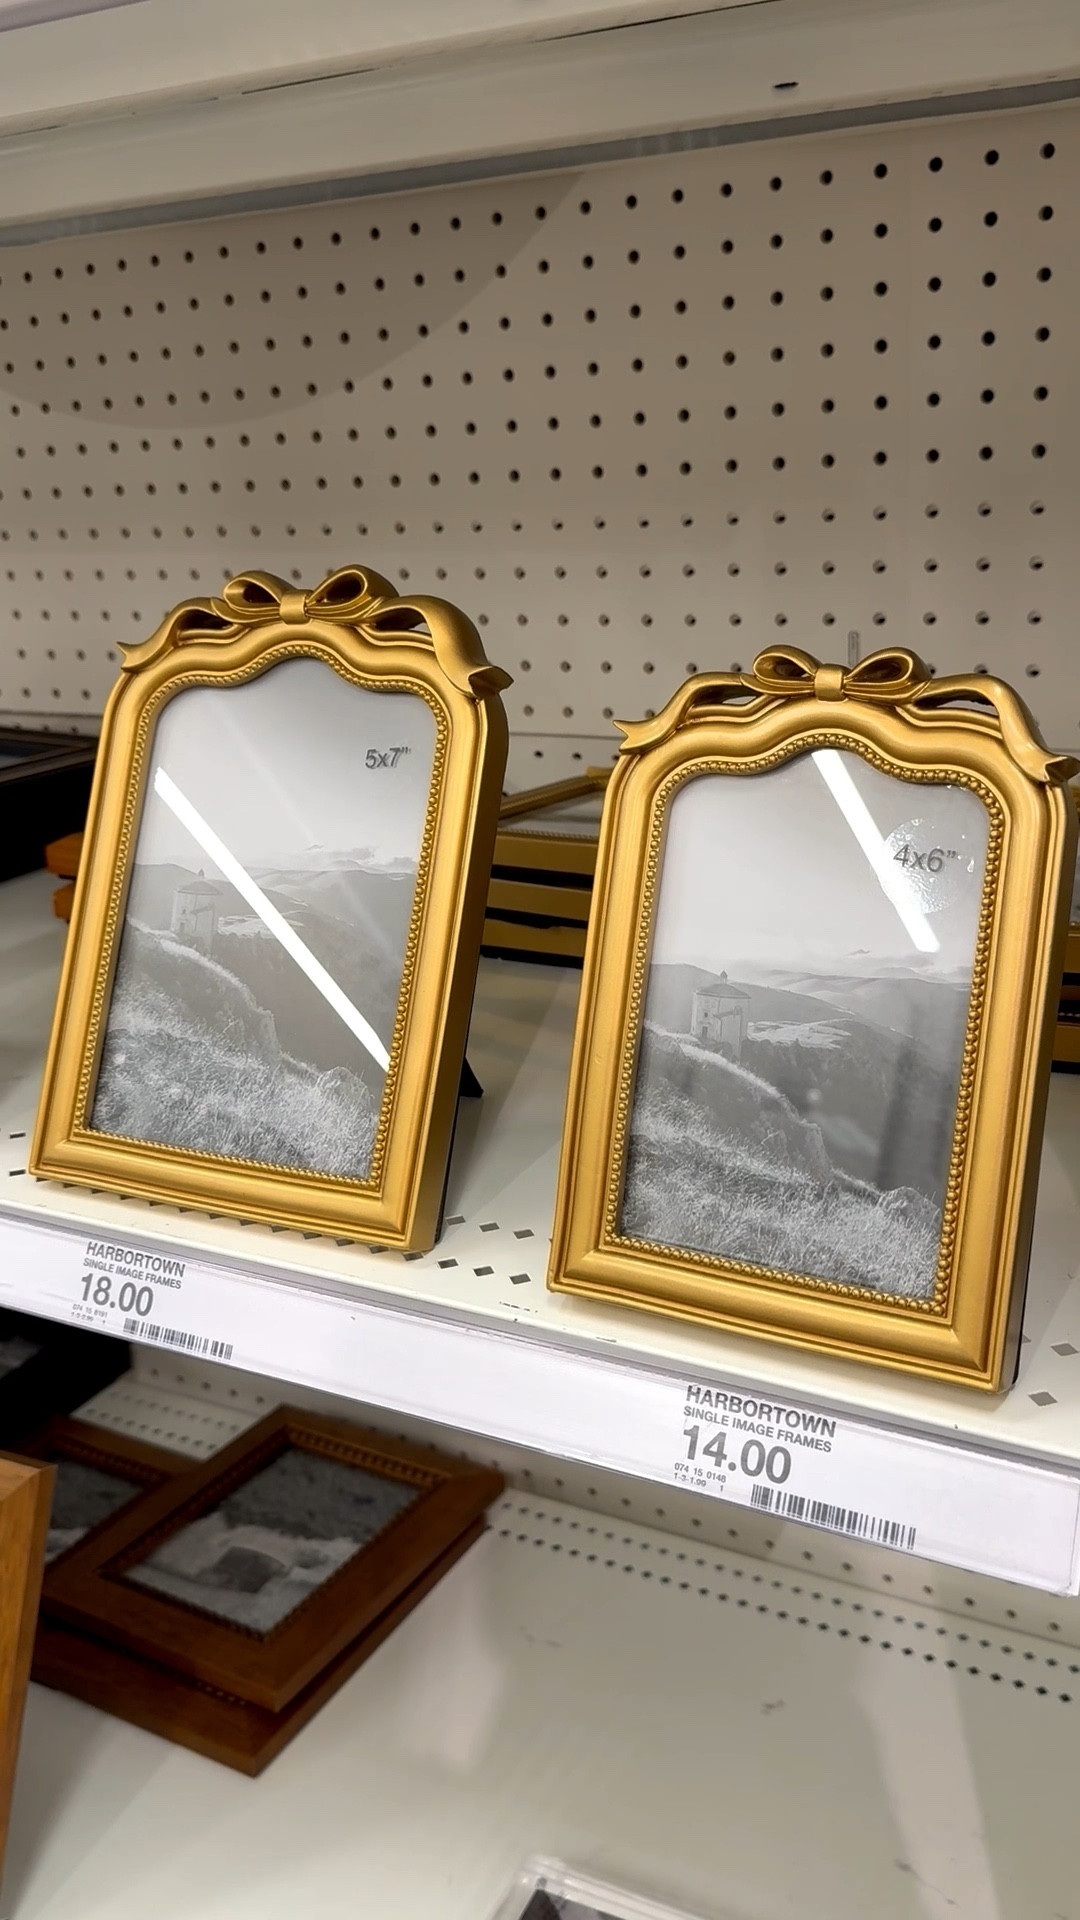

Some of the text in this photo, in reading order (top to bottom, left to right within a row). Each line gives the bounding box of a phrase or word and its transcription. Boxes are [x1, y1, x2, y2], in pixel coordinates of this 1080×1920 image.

[82, 1257, 182, 1289] SINGLE IMAGE FRAMES
[86, 1241, 186, 1277] HARBORTOWN
[81, 1273, 154, 1317] 18.00
[683, 1405, 832, 1453] SINGLE IMAGE FRAMES
[686, 1385, 837, 1438] HARBORTOWN
[674, 1462, 727, 1483] 074 15 0148
[683, 1424, 792, 1484] 14.00
